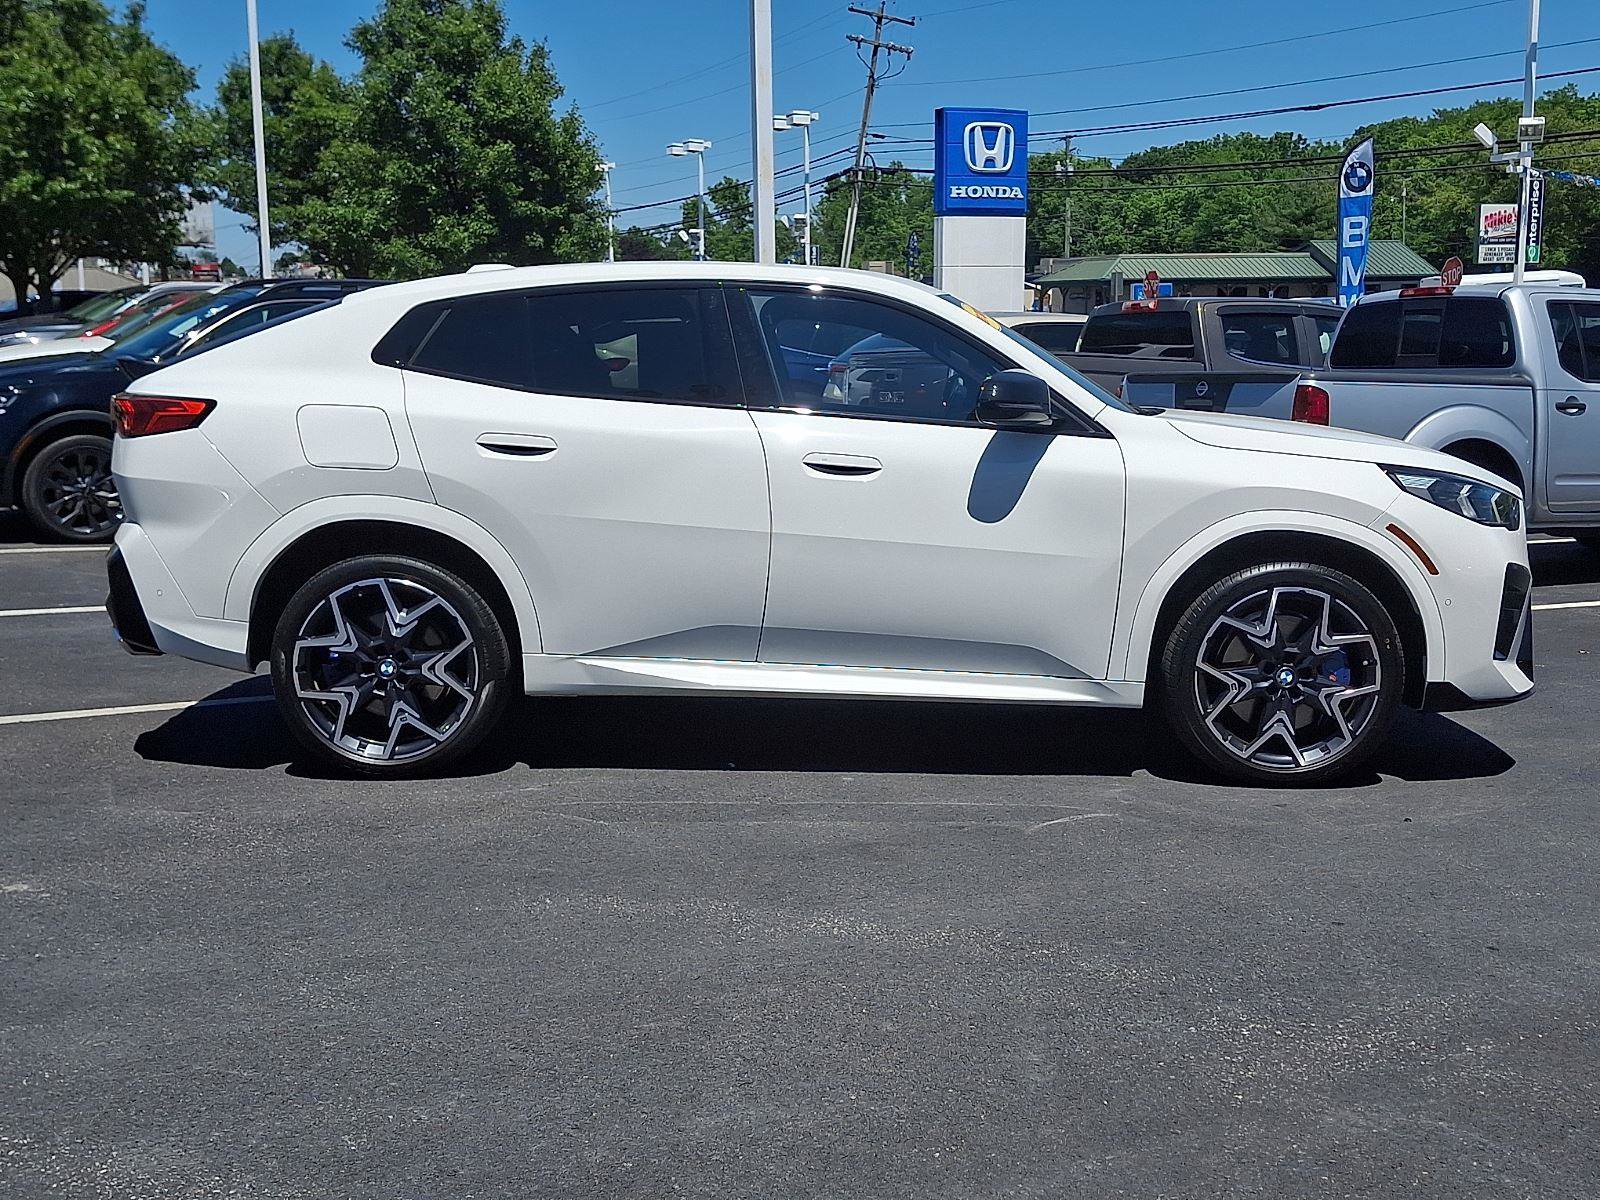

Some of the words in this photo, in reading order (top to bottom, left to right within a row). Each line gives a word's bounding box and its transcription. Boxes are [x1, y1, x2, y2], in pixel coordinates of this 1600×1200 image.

[949, 186, 1024, 199] HONDA
[1528, 180, 1540, 261] enterprise
[1442, 266, 1461, 286] STOP
